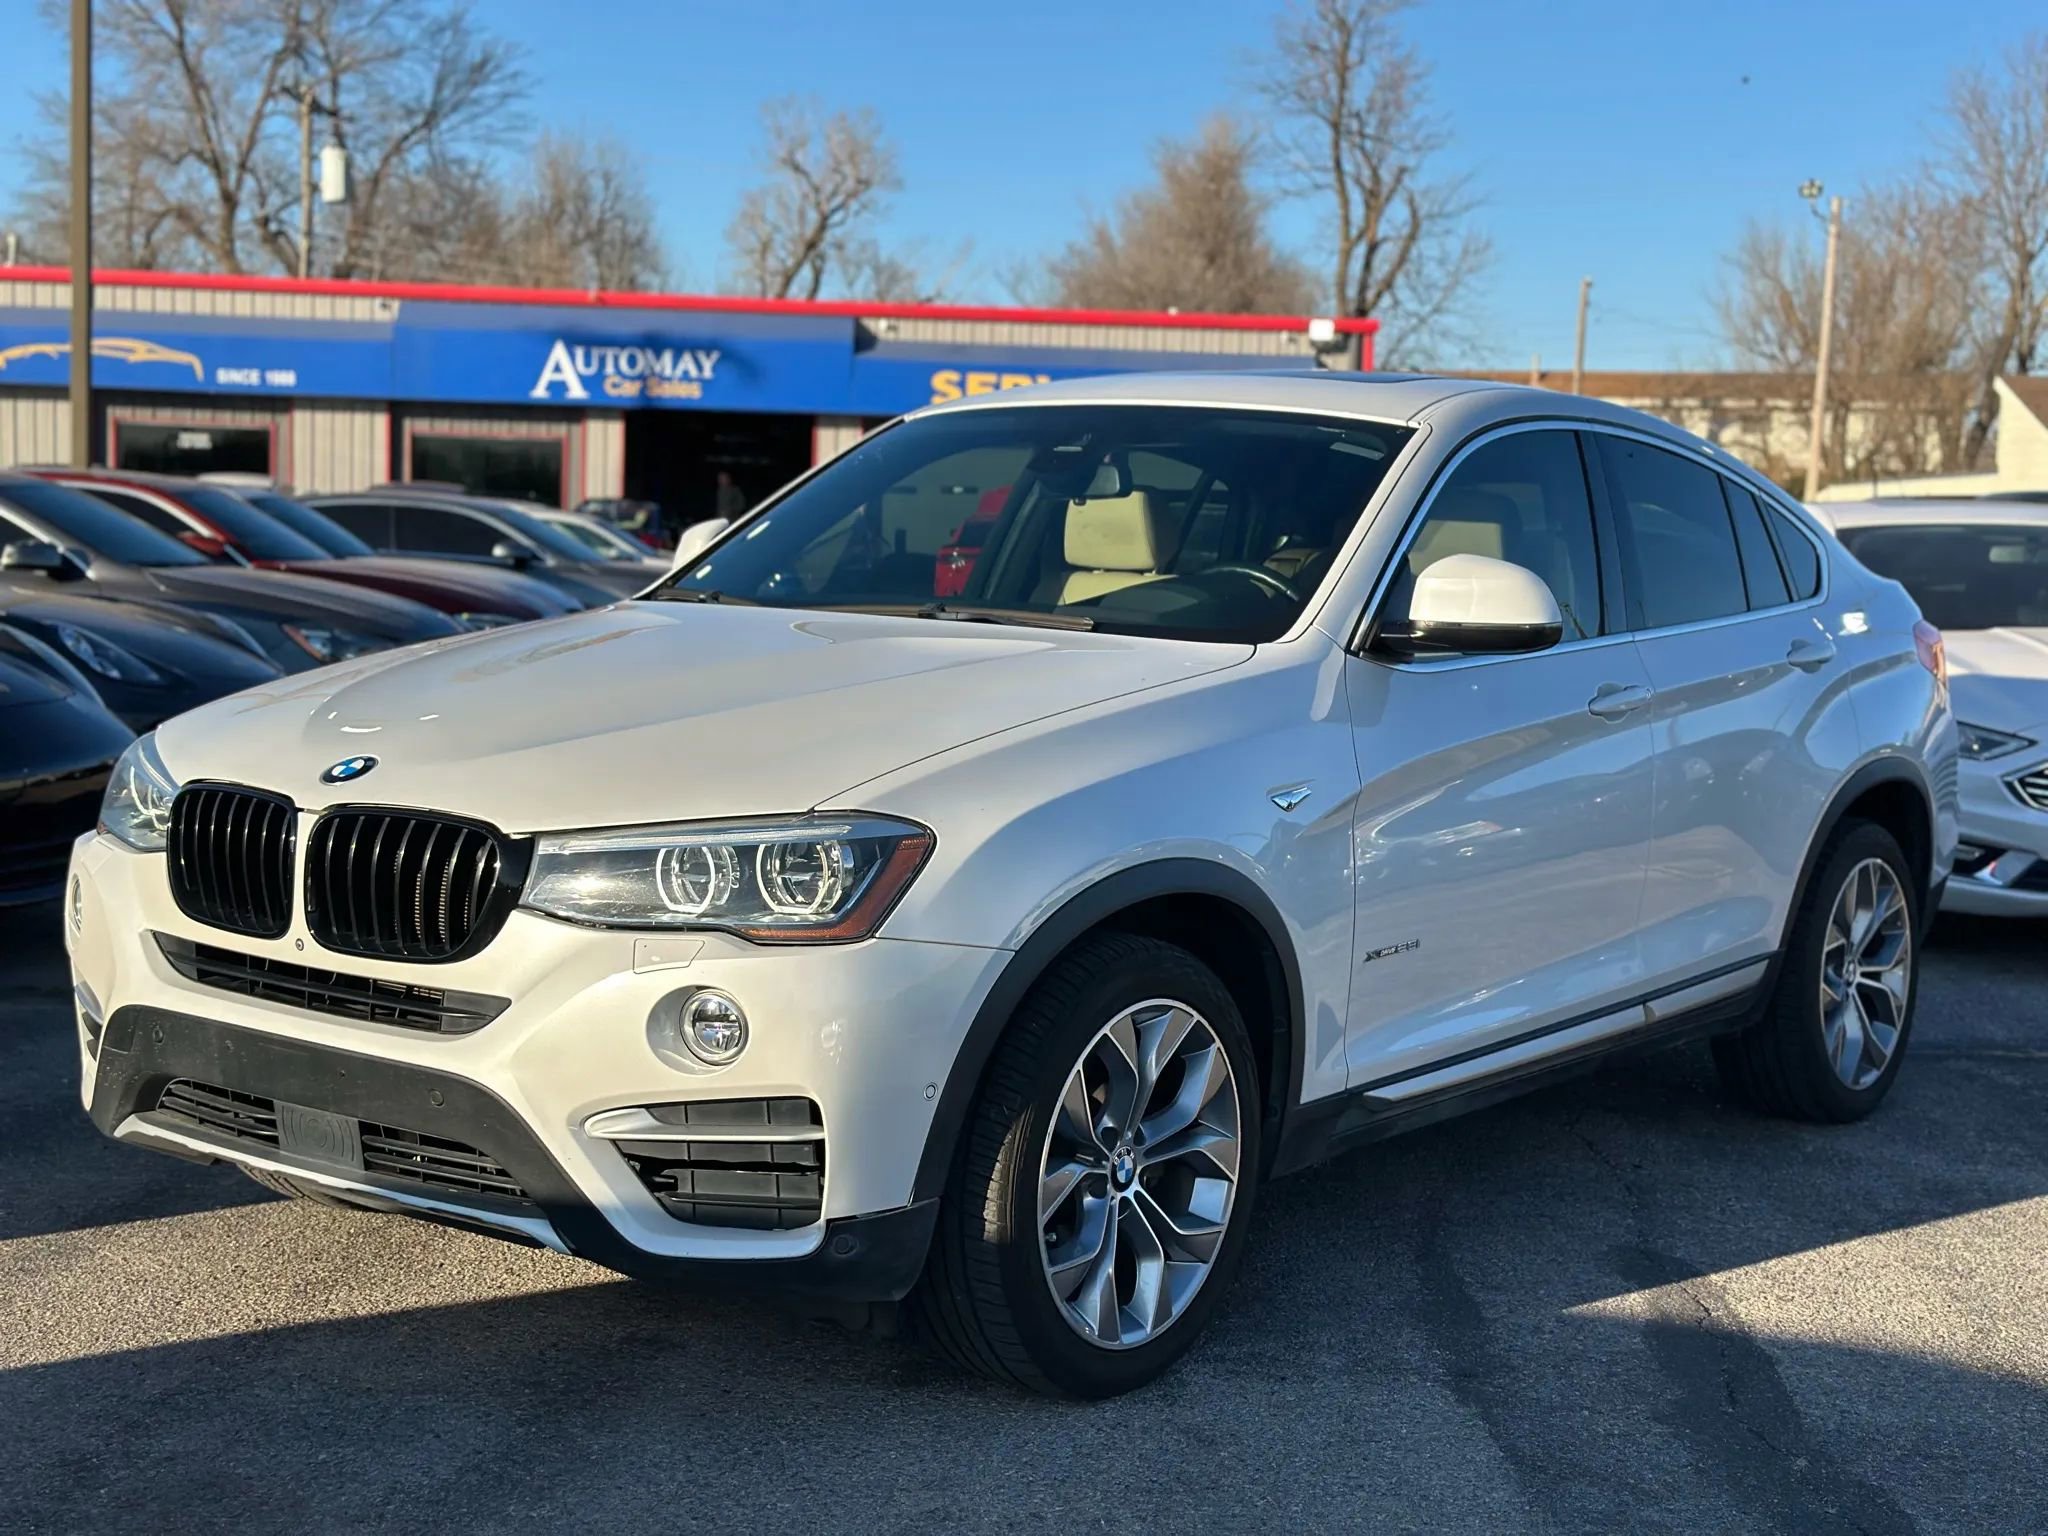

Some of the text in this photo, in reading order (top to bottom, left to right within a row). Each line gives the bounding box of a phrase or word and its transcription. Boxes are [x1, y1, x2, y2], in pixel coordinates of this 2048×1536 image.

[216, 368, 260, 386] SINCE
[530, 339, 720, 399] AUTOMAY
[603, 374, 702, 399] Car Sales
[931, 370, 1050, 405] SER
